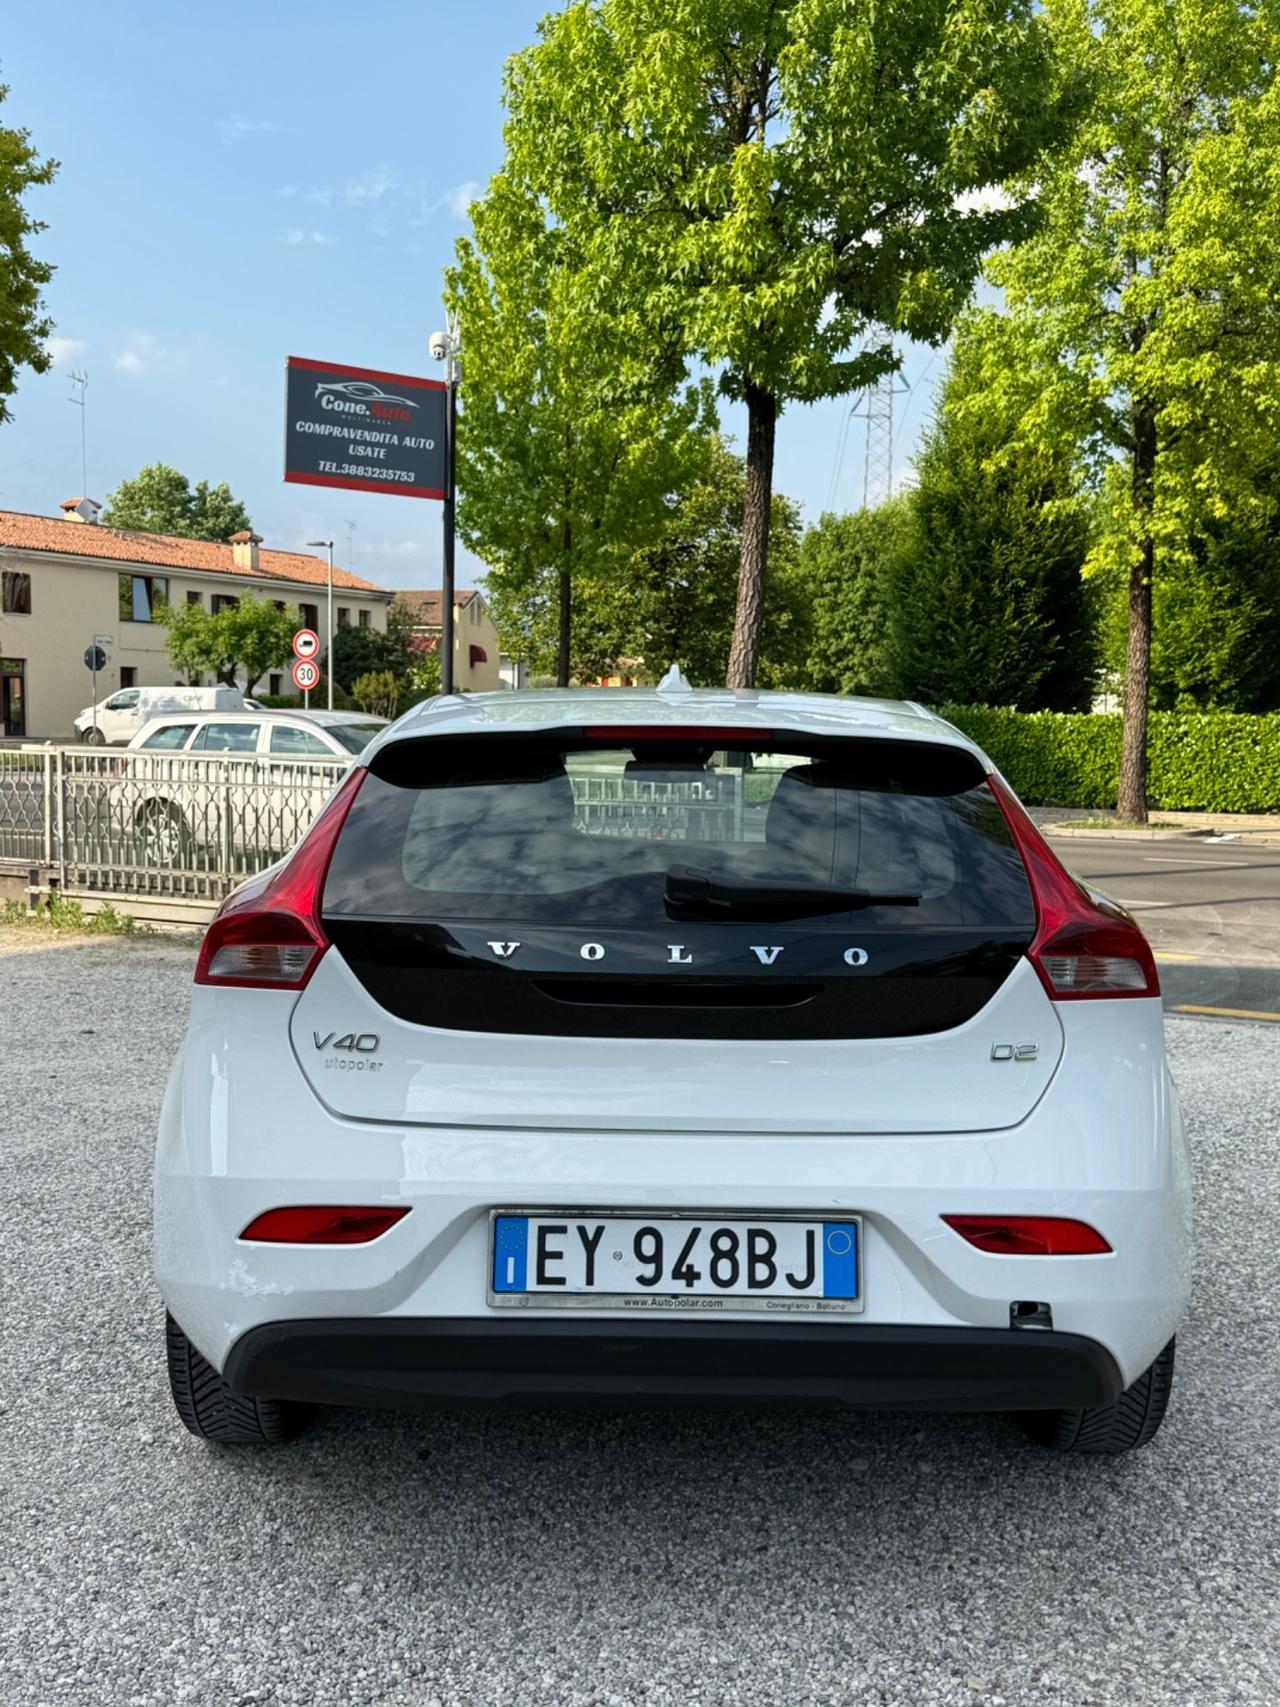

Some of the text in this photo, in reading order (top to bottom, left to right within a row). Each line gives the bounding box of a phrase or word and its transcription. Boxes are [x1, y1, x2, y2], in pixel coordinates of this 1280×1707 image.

[295, 420, 435, 450] COMPRAVENDITA AUTO
[348, 444, 388, 459] USATE
[318, 460, 416, 483] TEL.3883235753
[299, 667, 314, 681] 30
[487, 941, 869, 967] VOLVO
[312, 1031, 381, 1053] V40
[990, 1042, 1039, 1062] D2
[536, 1224, 816, 1290] EY 948BJ
[623, 1298, 724, 1309] www.Autopolar.com
[766, 1301, 810, 1311] Conegliano
